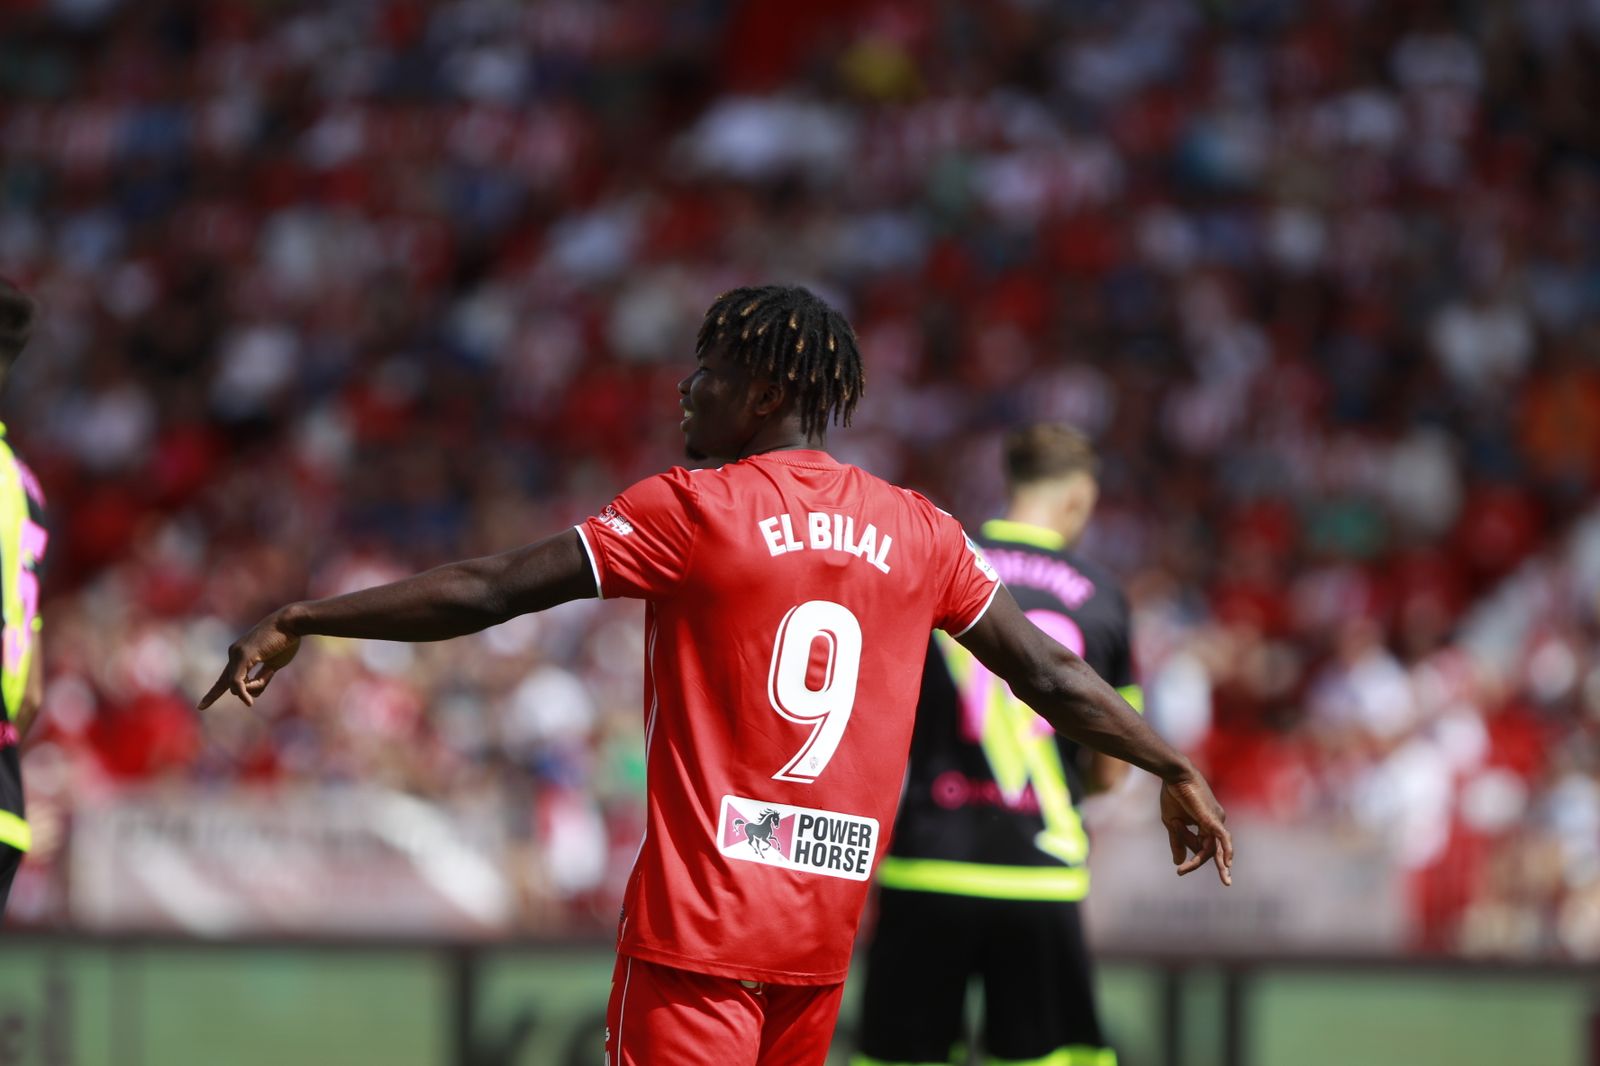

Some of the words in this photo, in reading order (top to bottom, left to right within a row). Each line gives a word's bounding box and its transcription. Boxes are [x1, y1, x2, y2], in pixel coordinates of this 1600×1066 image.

[759, 514, 804, 557] EL
[808, 511, 893, 574] BILAL
[767, 600, 863, 784] 9
[797, 814, 873, 848] POWER
[794, 840, 870, 874] HORSE
